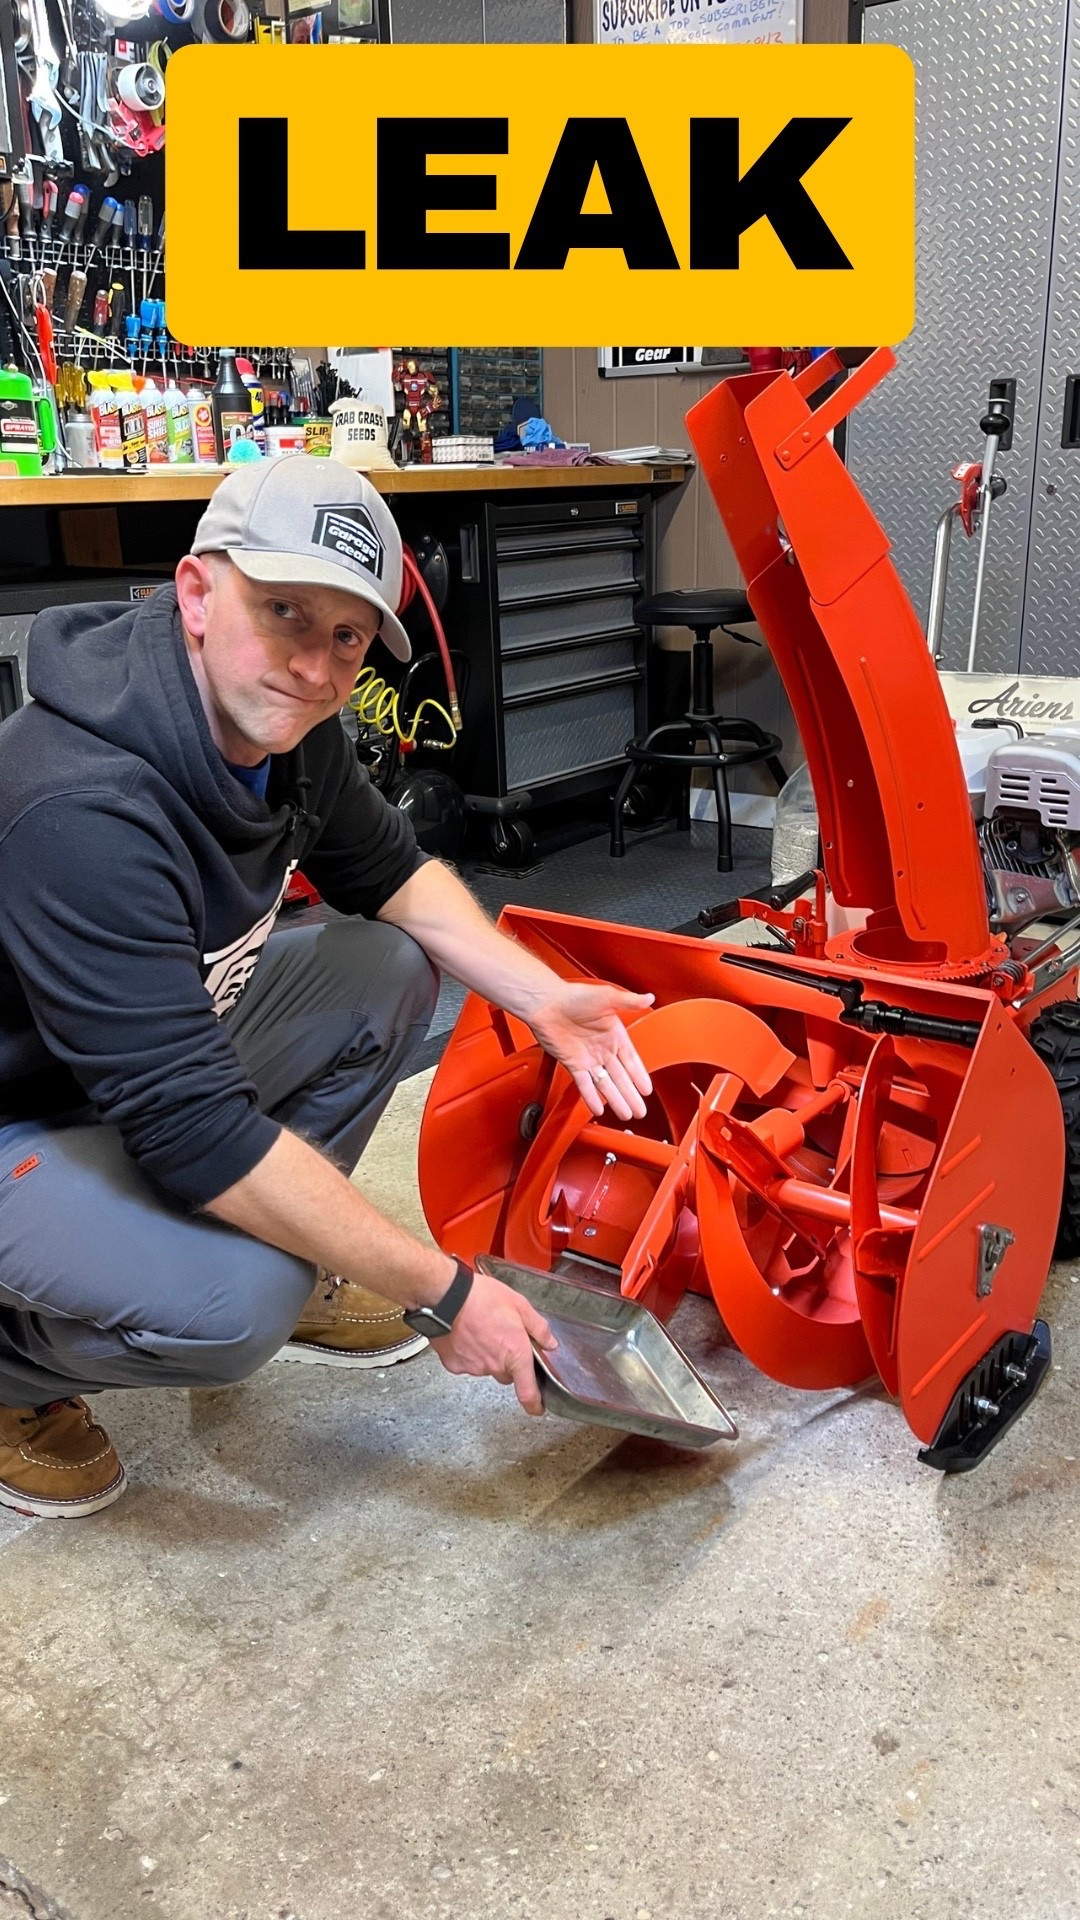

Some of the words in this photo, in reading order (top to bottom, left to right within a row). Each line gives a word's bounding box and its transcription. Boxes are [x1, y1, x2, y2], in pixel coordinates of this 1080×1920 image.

[633, 27, 649, 42] BE
[669, 17, 690, 30] TOP
[635, 347, 671, 362] Gear
[335, 411, 355, 428] CRAB
[358, 411, 384, 428] GRASS
[305, 427, 329, 436] SLIP
[347, 428, 376, 441] SEEDS
[328, 525, 377, 559] Garage
[335, 541, 370, 564] Gear
[968, 681, 1074, 721] Ariens
